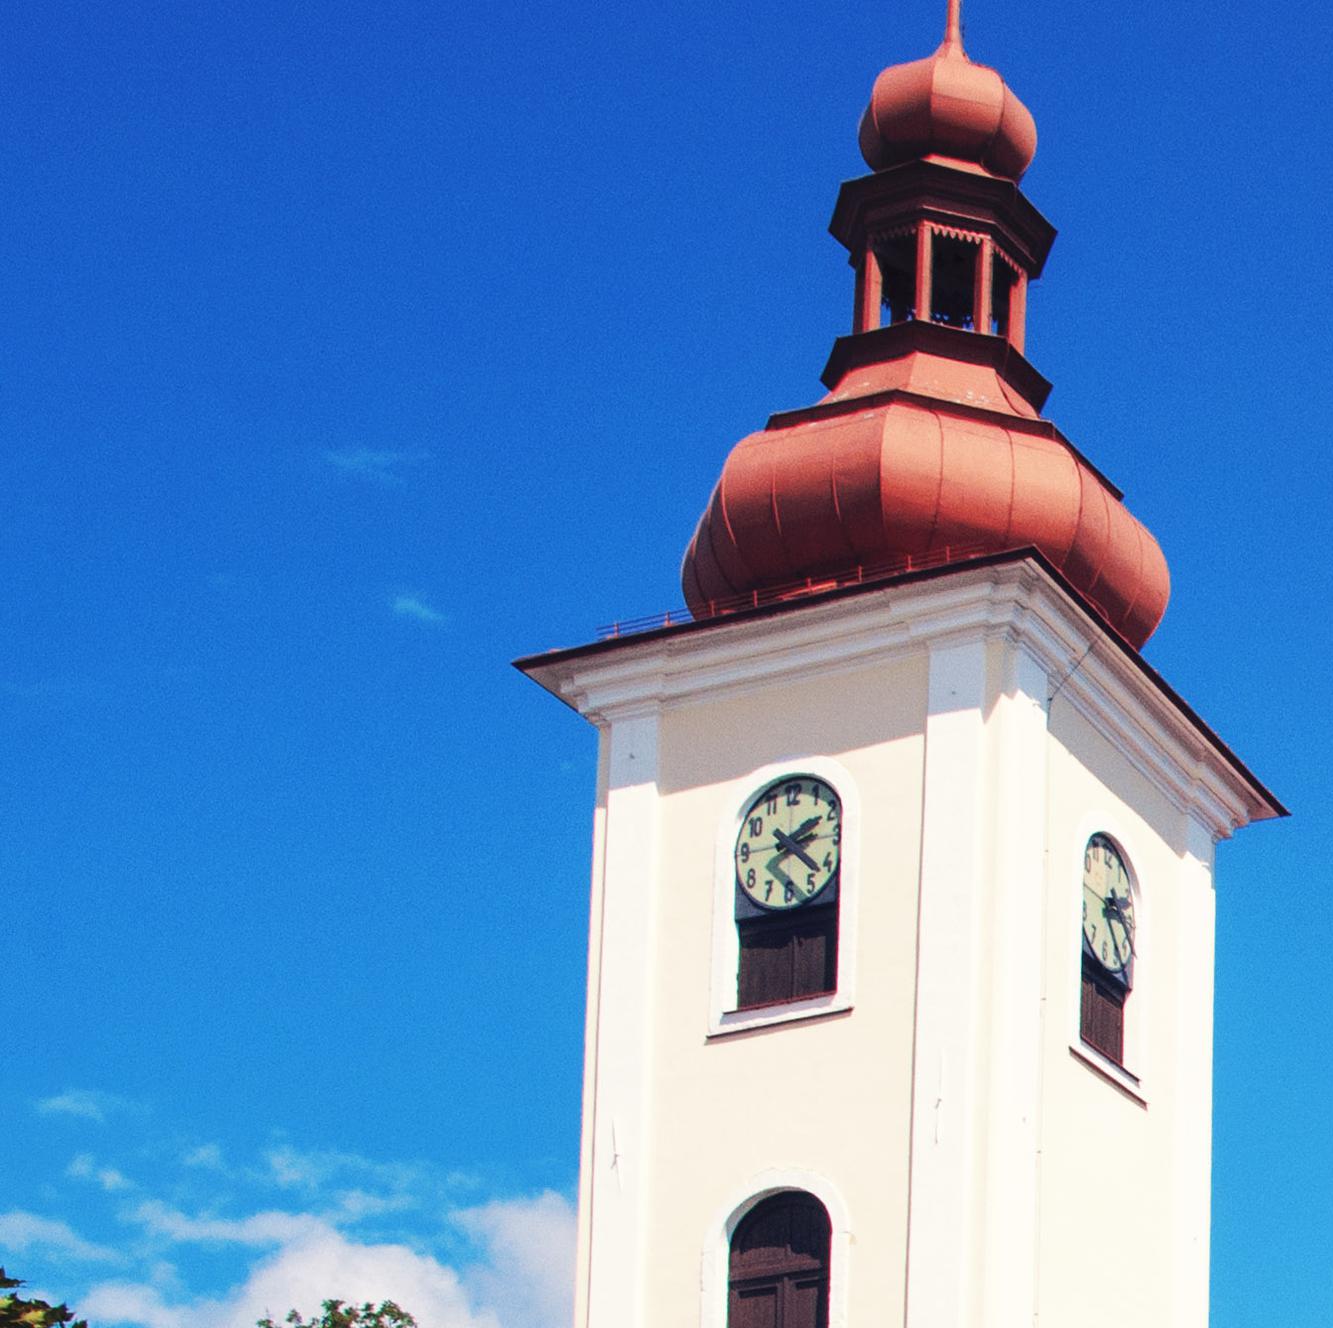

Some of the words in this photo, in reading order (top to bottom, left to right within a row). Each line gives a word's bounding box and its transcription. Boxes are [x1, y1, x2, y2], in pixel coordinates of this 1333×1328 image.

[765, 793, 778, 816] 11
[785, 783, 801, 807] 12
[812, 783, 820, 806] 1
[827, 799, 837, 821] 2
[749, 817, 763, 838] 10
[740, 842, 750, 863] 9
[823, 851, 833, 873] 4
[746, 868, 756, 889] 8
[806, 873, 816, 894] 5
[764, 879, 774, 902] 7
[784, 880, 795, 903] 6
